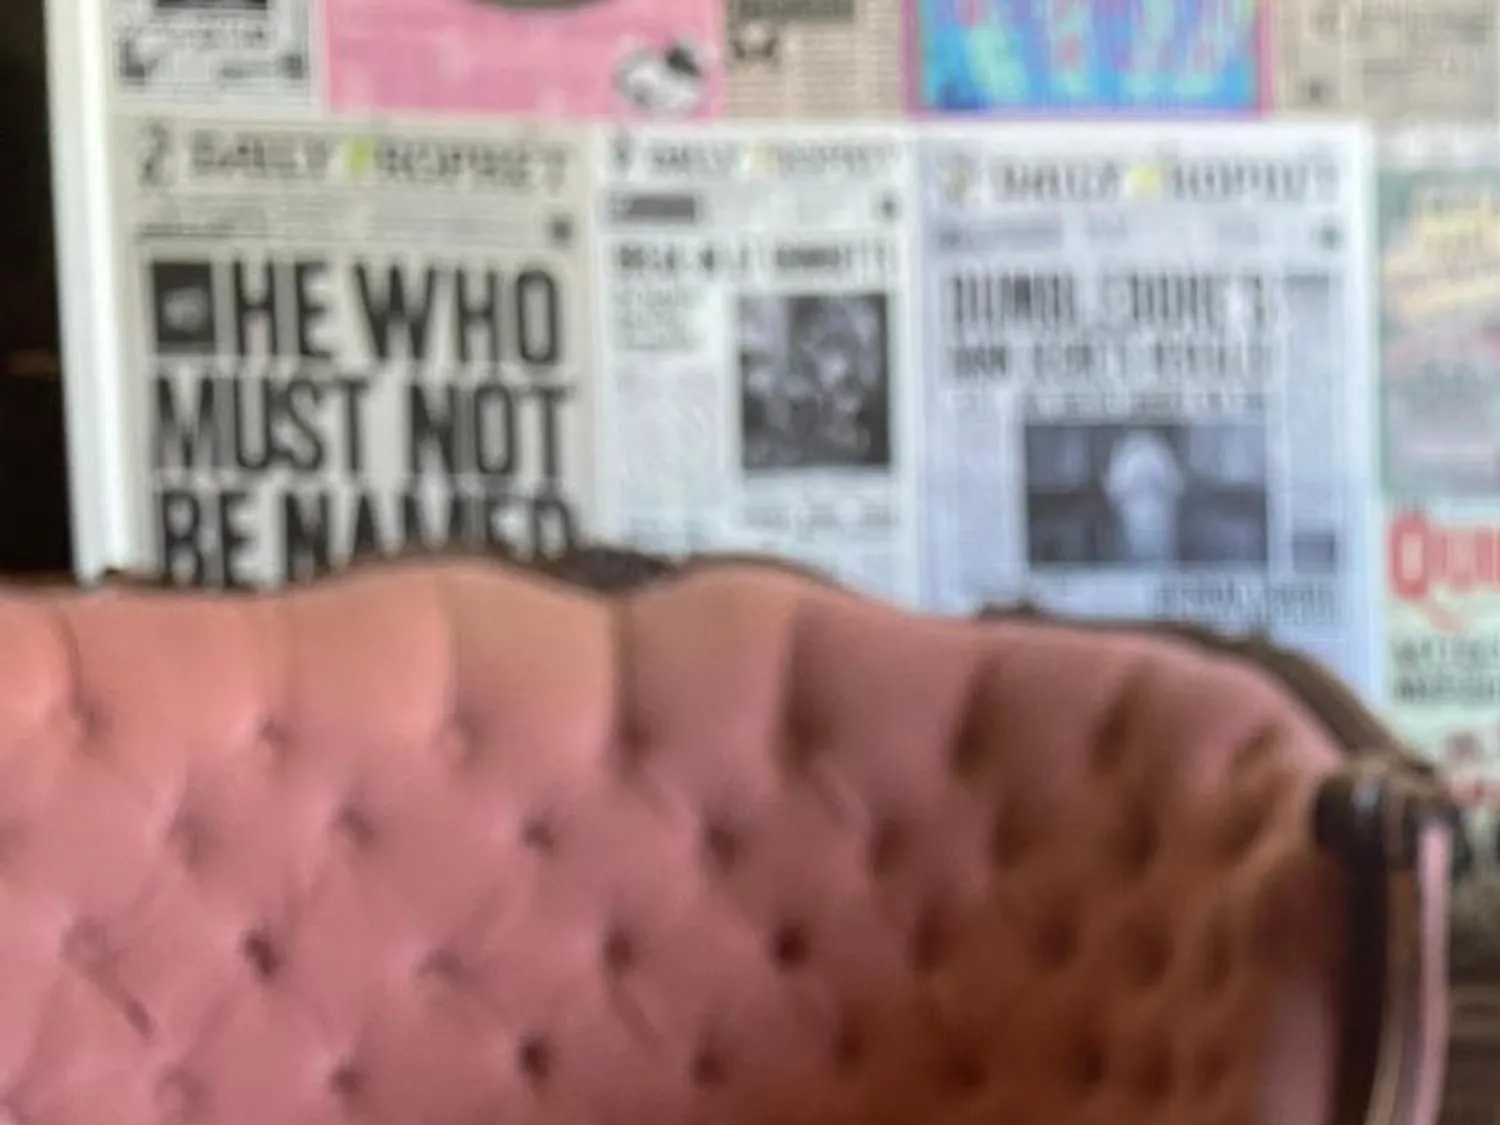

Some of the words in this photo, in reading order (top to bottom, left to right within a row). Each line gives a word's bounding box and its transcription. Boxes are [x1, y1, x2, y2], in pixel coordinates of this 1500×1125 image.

[233, 258, 335, 362] HE
[354, 260, 561, 366] WHO
[155, 376, 368, 474] MUST
[410, 383, 574, 478] NOT
[162, 488, 254, 590] BE
